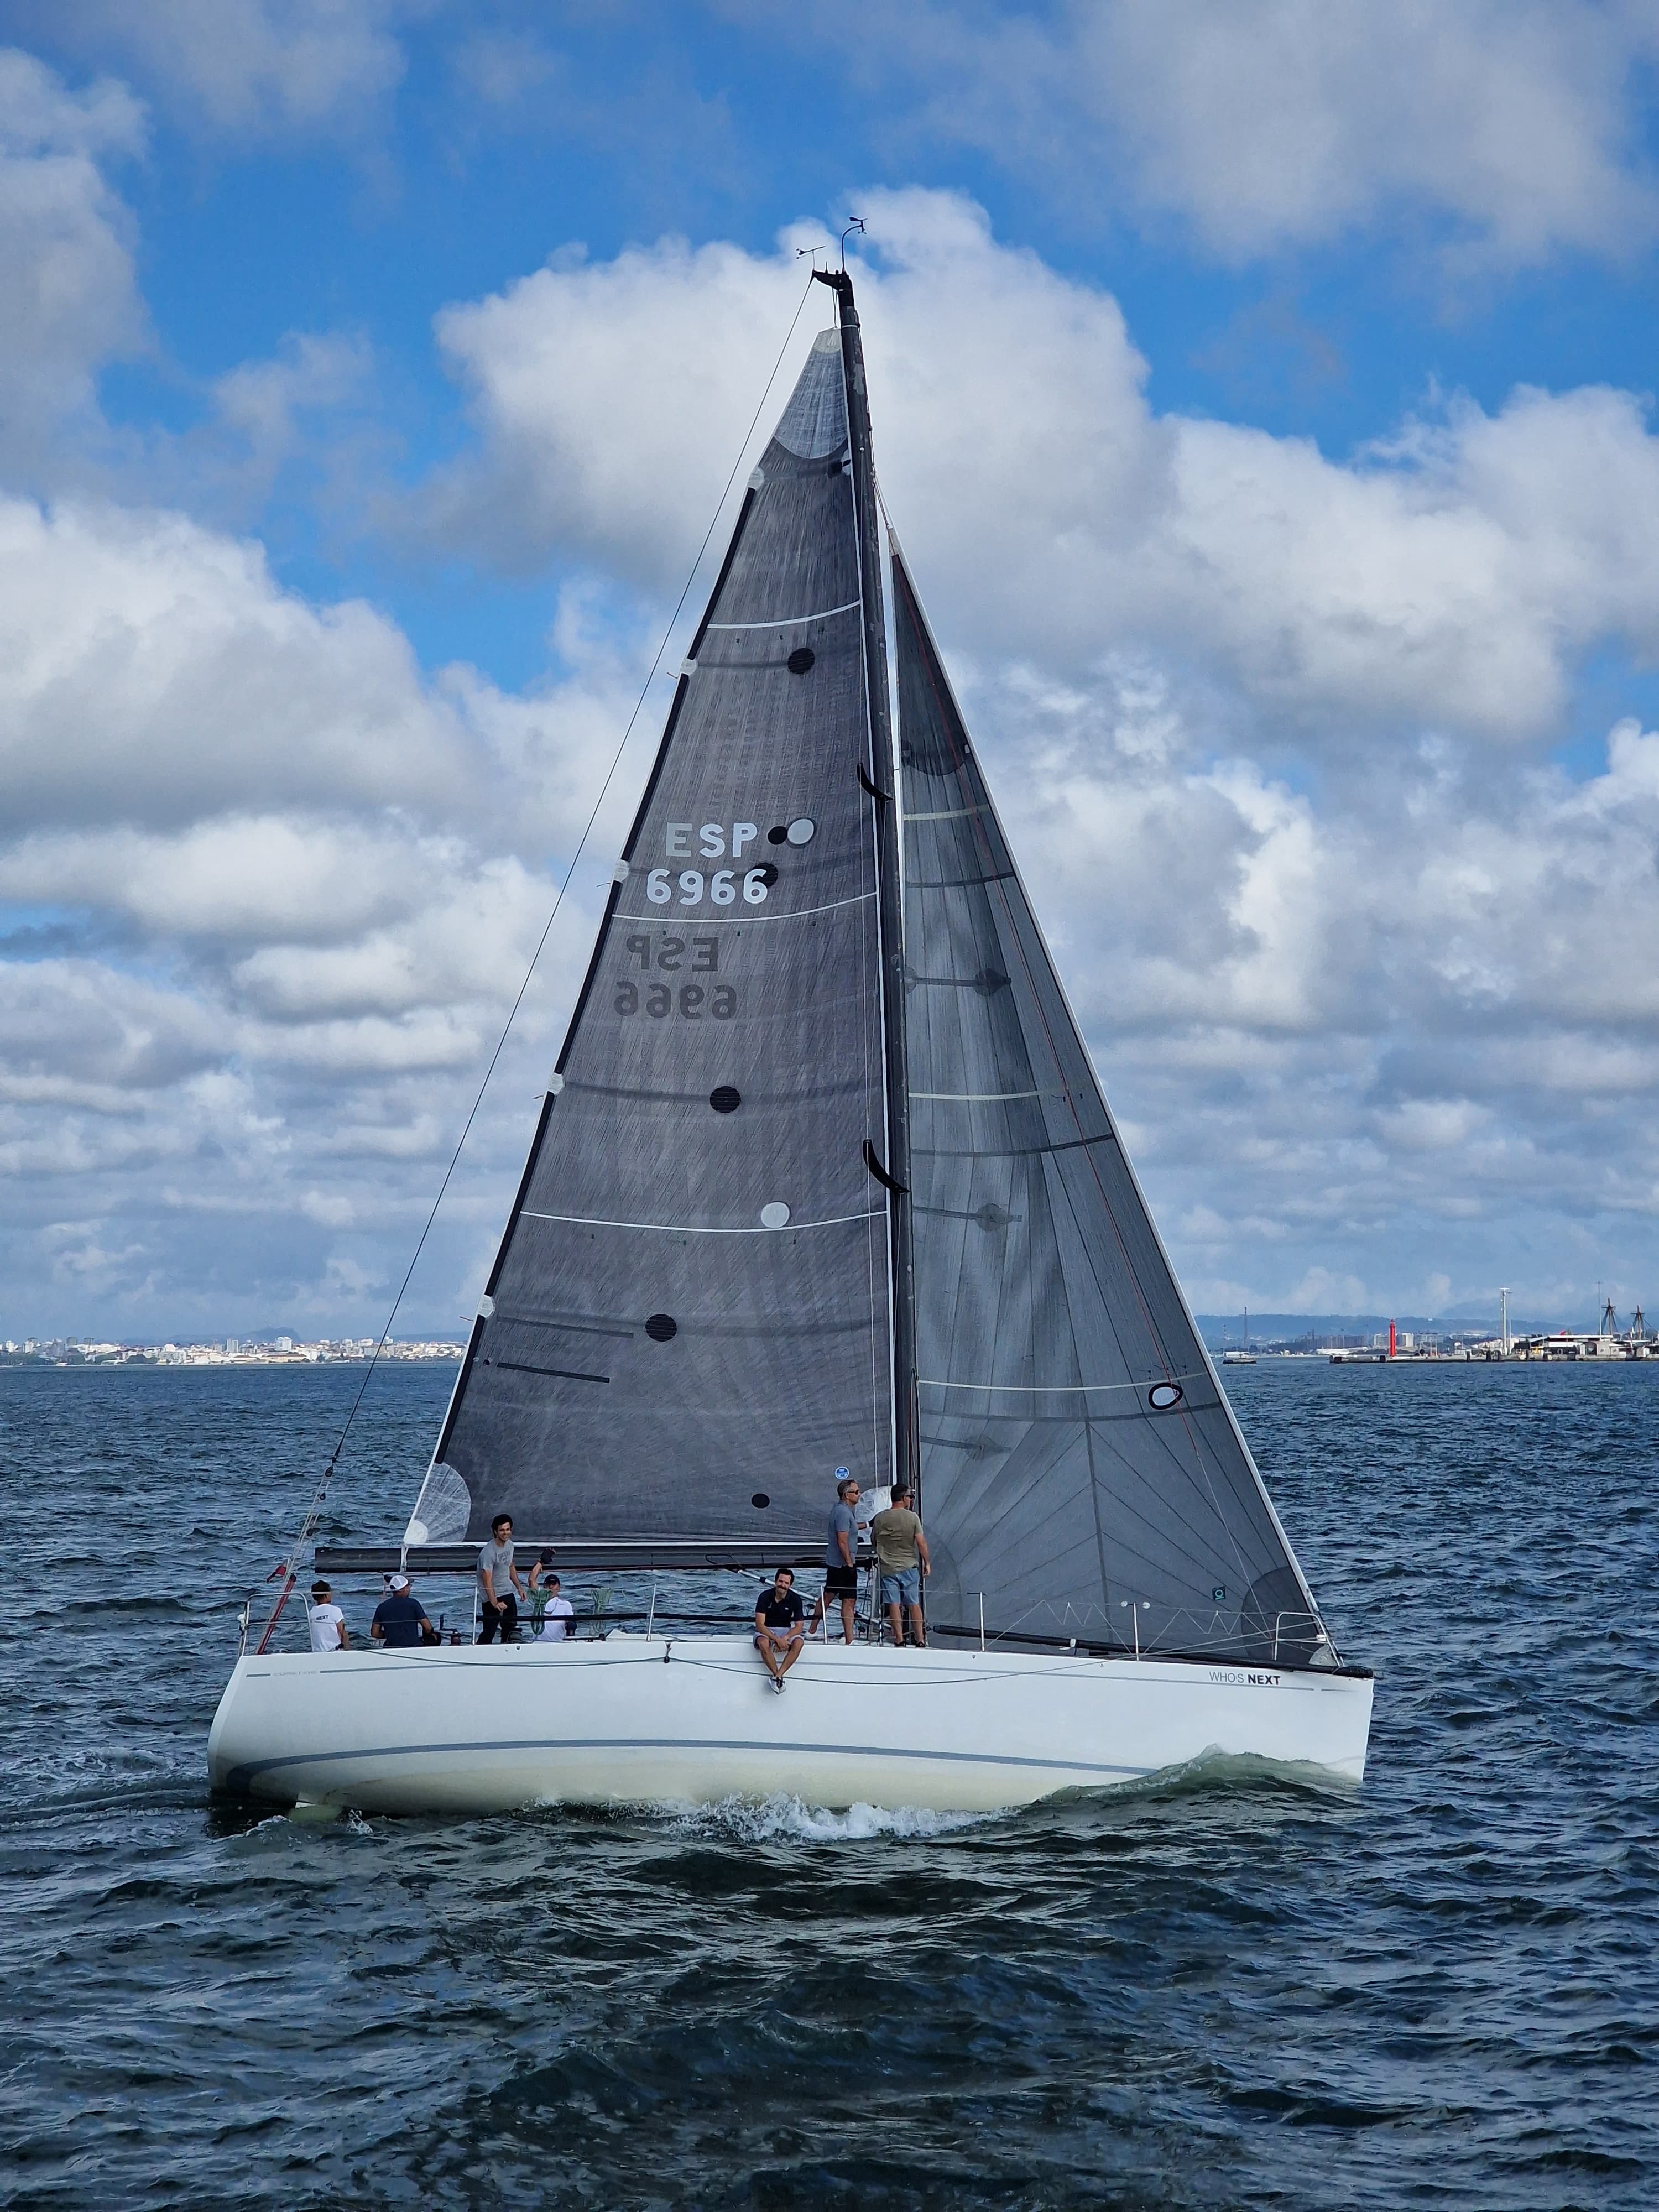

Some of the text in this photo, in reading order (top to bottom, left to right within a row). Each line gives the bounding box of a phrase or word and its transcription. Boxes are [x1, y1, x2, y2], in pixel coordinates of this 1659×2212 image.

[666, 822, 758, 858] ESP
[646, 868, 768, 905] 6966
[1248, 1674, 1281, 1685] NEXT
